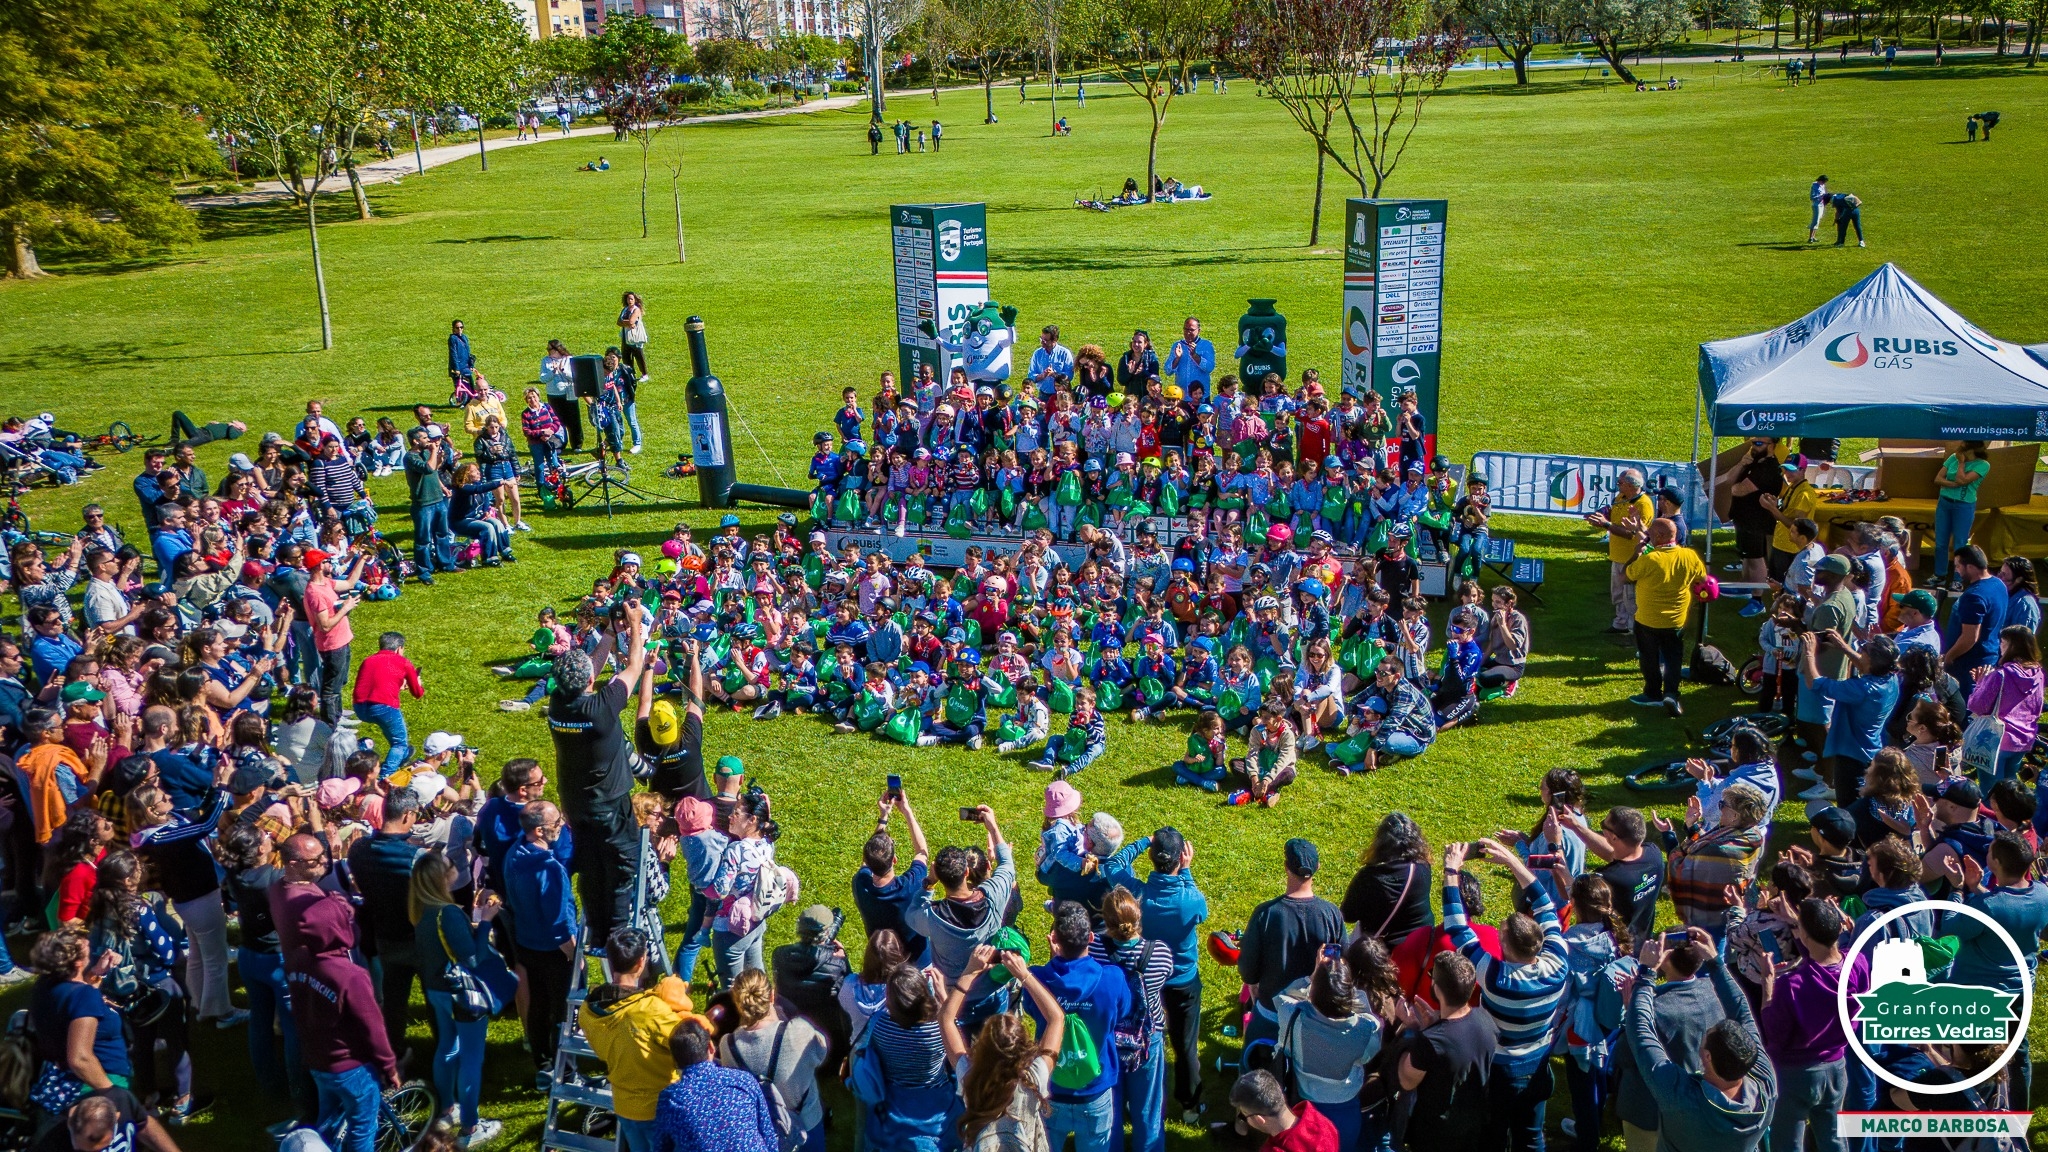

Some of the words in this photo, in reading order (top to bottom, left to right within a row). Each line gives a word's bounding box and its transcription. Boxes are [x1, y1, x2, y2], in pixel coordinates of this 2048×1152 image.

[963, 227, 982, 235] Turismo
[963, 233, 979, 241] Centro
[963, 239, 984, 247] Portugal
[1873, 337, 1959, 356] RUBiS
[912, 349, 921, 378] UBiS
[1873, 355, 1913, 370] GÁS
[1758, 412, 1797, 422] RUBiS
[1757, 421, 1775, 431] GÁS
[1941, 425, 2029, 436] www.rubisgas.pt
[1588, 494, 1609, 510] GÁ
[853, 539, 882, 549] RUBiS
[1965, 751, 1990, 767] UMNI
